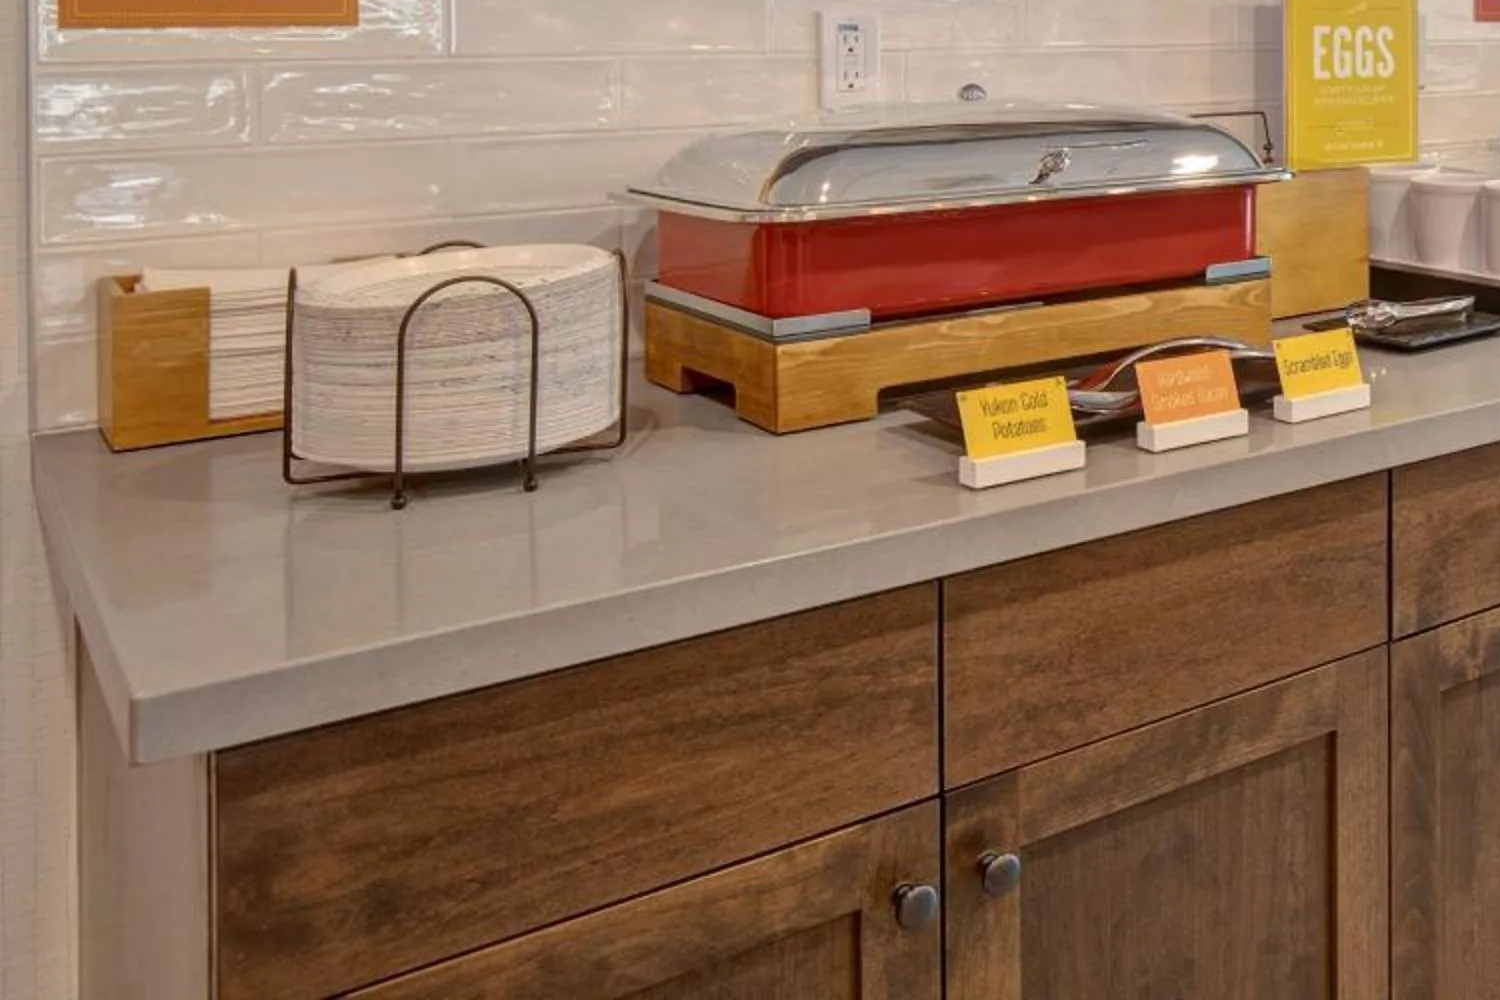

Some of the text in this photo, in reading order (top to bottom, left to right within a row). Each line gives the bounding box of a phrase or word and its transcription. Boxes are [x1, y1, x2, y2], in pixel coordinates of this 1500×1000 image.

[1312, 25, 1395, 80] EGGS
[1283, 353, 1331, 376] Scrambled
[979, 391, 1049, 417] Yukon Gold
[991, 418, 1047, 440] Potatoes
